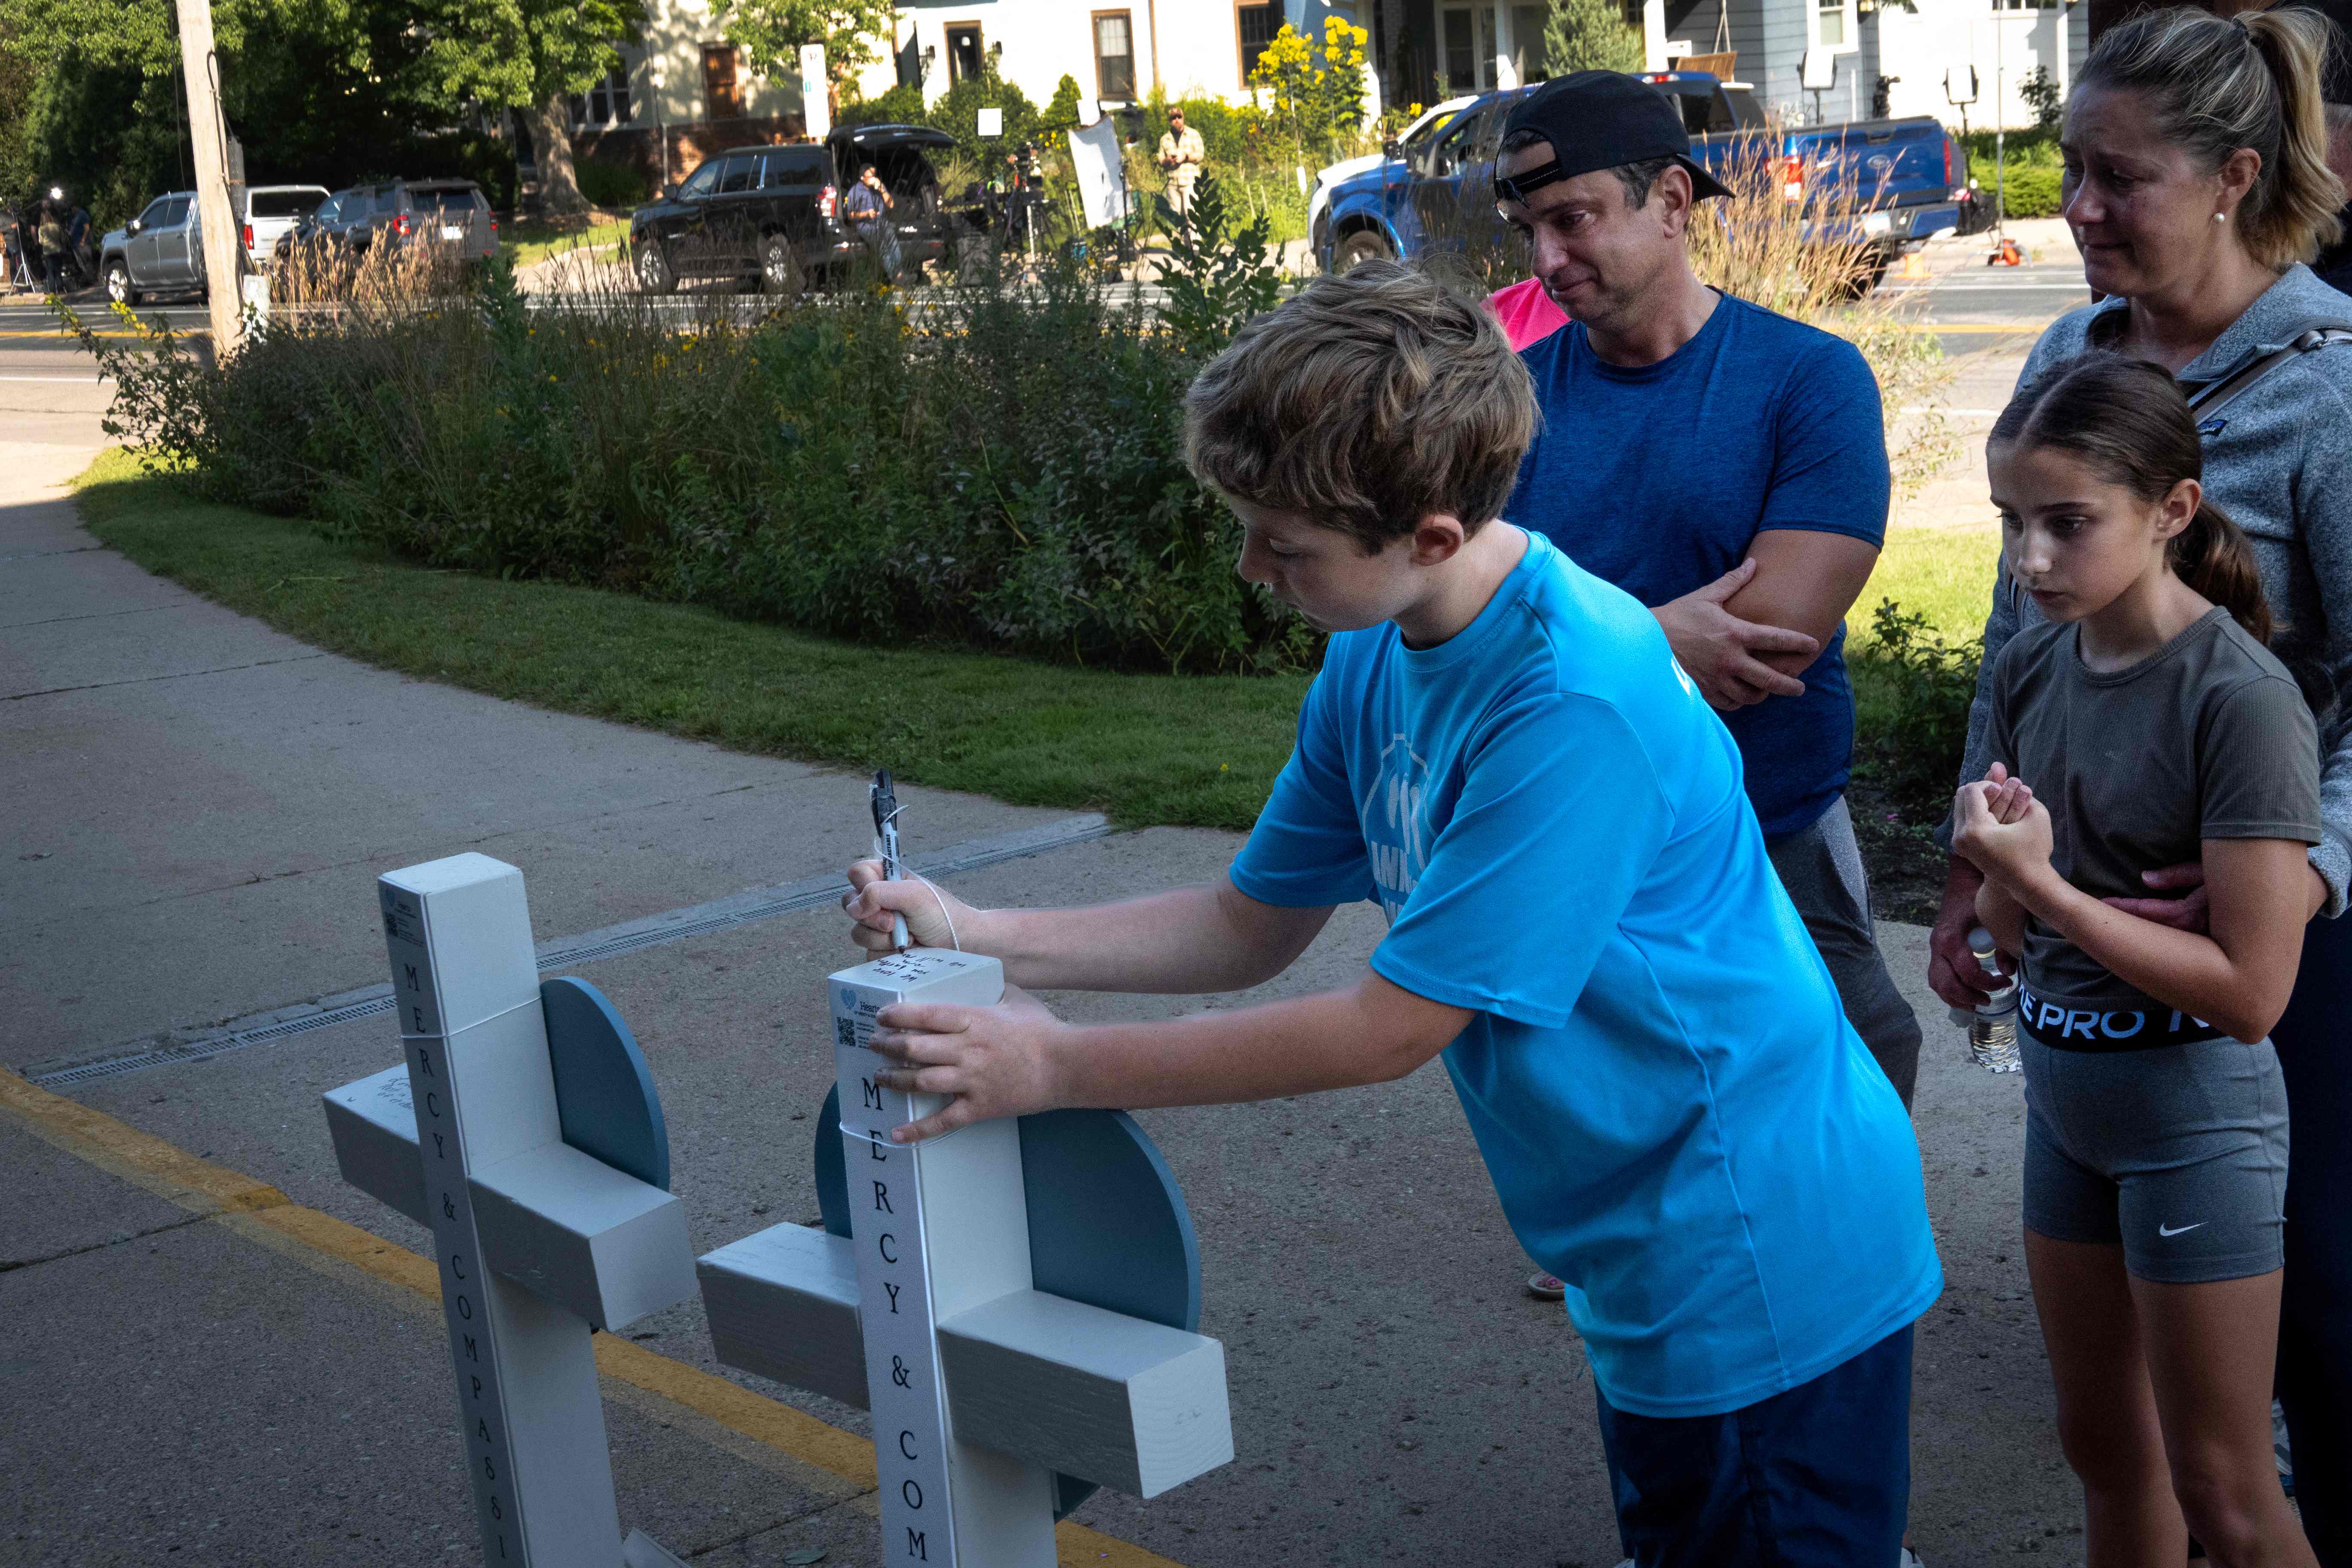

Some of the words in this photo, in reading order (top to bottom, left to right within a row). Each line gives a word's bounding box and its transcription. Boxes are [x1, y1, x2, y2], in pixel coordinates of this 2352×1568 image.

[404, 963, 444, 1159] MERCY
[2037, 1002, 2145, 1039] PRO
[861, 1077, 901, 1314] MERCY
[893, 1355, 912, 1389] &
